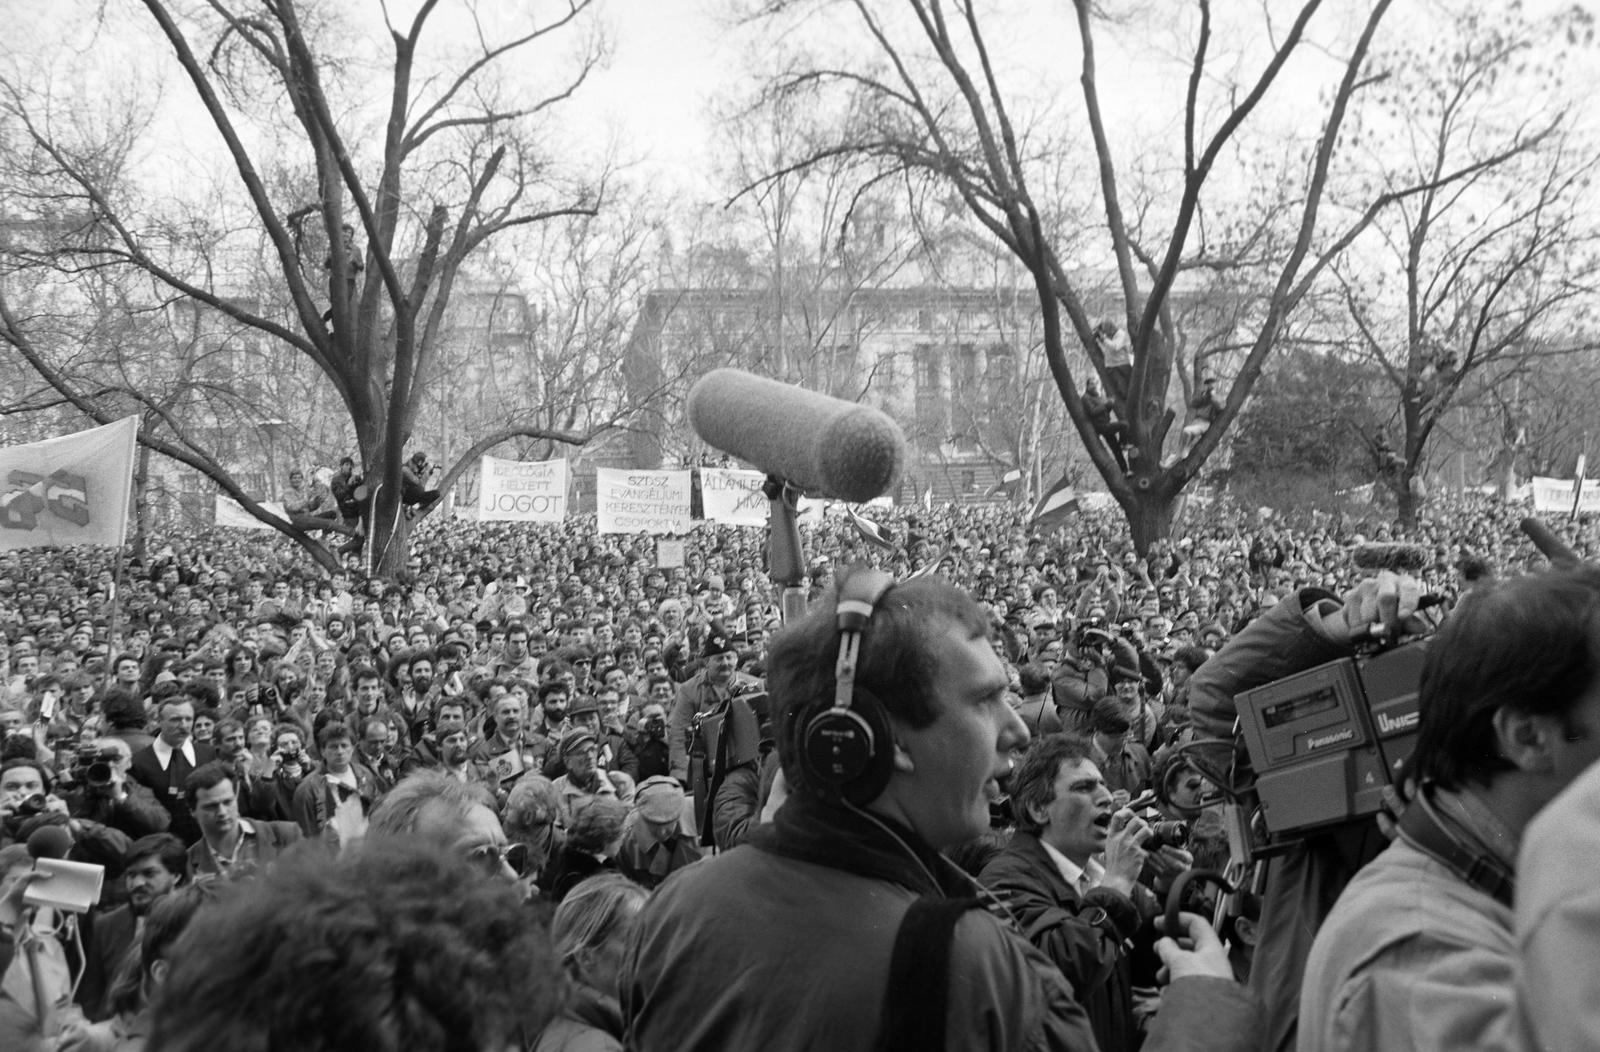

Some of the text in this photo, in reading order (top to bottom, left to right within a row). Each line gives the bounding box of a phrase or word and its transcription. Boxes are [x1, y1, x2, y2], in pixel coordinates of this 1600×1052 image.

[501, 480, 551, 491] HELYETT
[628, 475, 669, 488] SZDSZ
[485, 493, 563, 514] JOGOT
[1307, 728, 1354, 750] Panasonic
